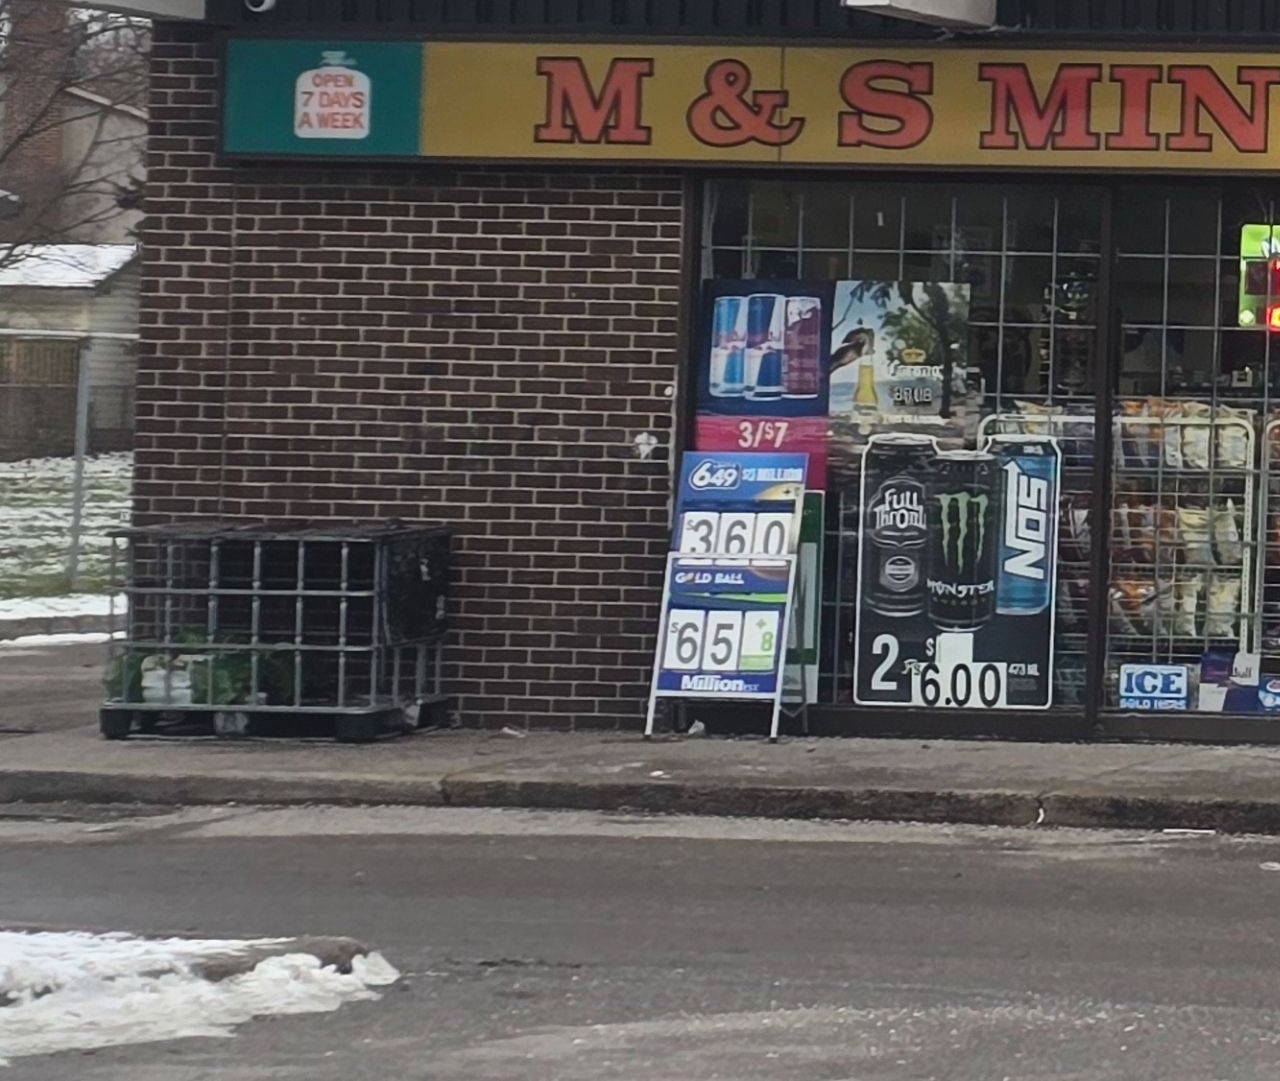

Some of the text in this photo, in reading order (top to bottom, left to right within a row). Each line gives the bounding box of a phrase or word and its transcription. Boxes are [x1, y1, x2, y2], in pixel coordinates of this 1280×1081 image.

[312, 74, 353, 87] OPEN
[301, 91, 364, 108] 7 DAYS
[534, 57, 653, 145] M
[686, 58, 805, 147] &
[837, 60, 934, 149] S
[298, 112, 364, 129] A WEEK
[1003, 460, 1048, 579] NOS
[871, 634, 899, 690] 2
[1125, 671, 1183, 694] ICE
